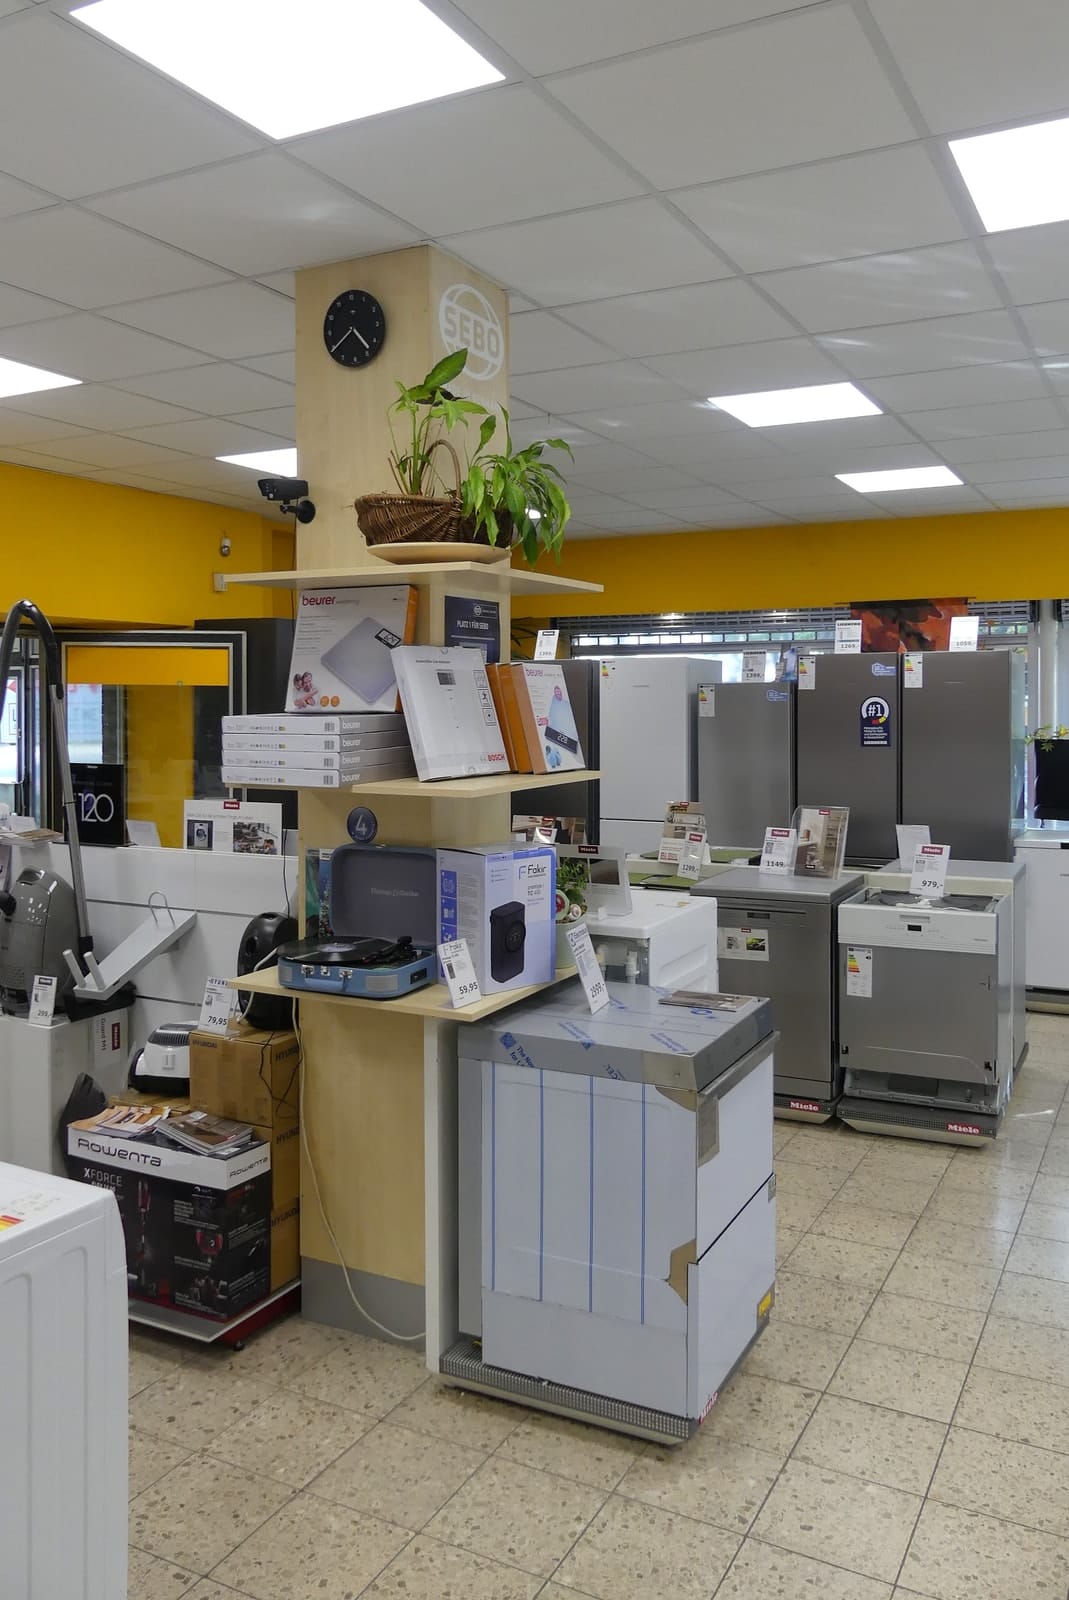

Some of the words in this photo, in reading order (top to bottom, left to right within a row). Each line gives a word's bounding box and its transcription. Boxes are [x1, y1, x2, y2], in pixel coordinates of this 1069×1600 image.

[444, 304, 500, 359] SEBO
[302, 595, 336, 607] beurer
[868, 704, 882, 717] #1
[487, 753, 505, 763] BOSCH
[78, 792, 115, 823] 120
[355, 814, 367, 836] 4
[527, 863, 547, 874] Fakir
[921, 879, 943, 889] 979,-
[459, 981, 478, 995] 59,95
[207, 1015, 228, 1026] 79,95
[790, 1101, 819, 1112] Miele
[947, 1124, 980, 1135] Miele
